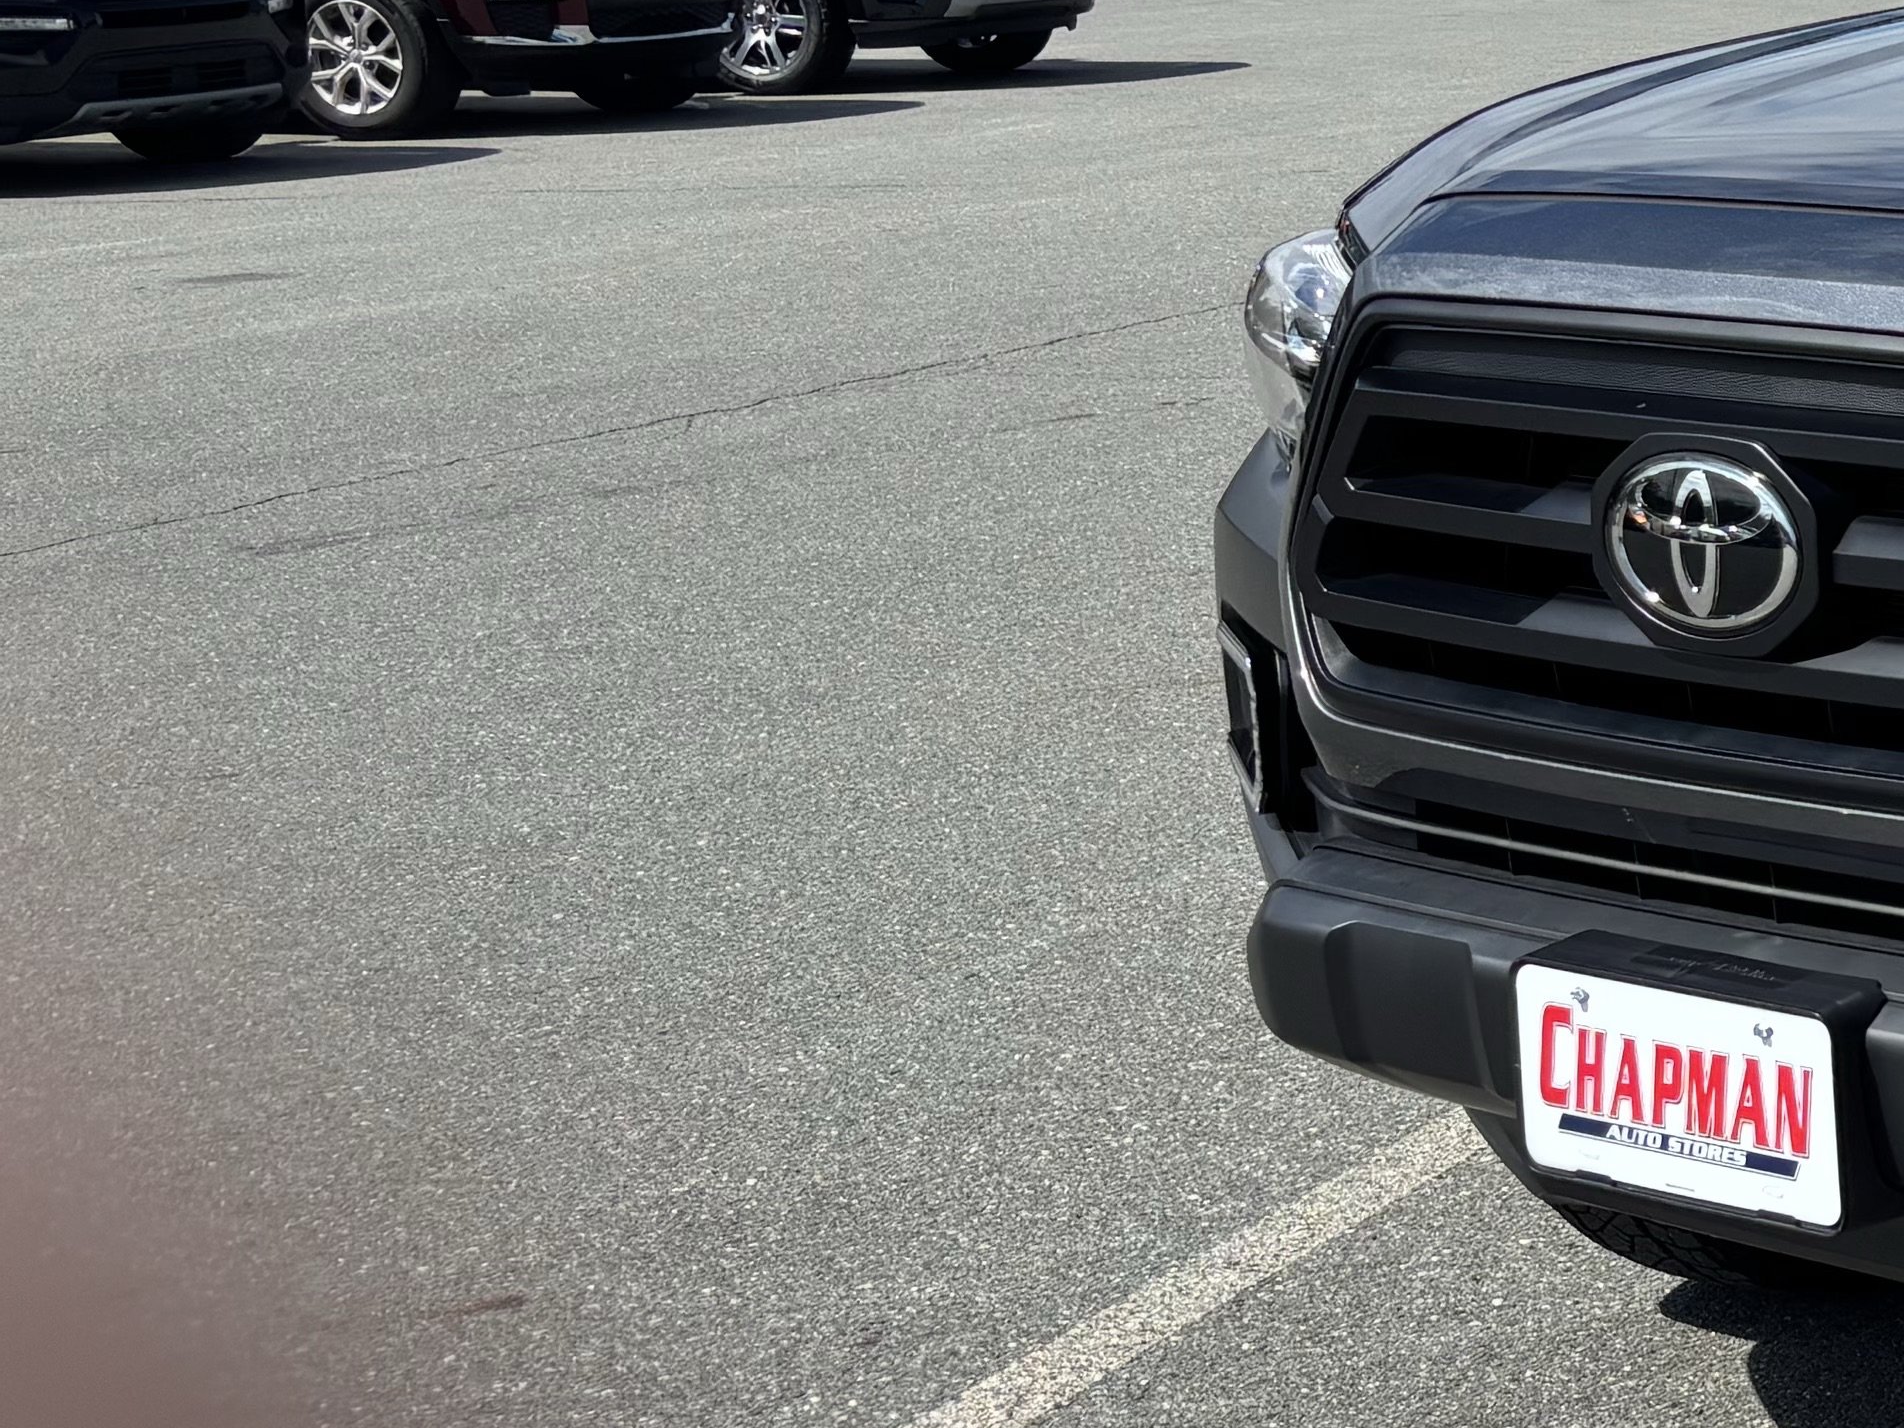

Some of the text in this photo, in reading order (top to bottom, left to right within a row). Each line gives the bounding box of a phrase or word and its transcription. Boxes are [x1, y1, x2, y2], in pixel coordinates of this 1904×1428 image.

[1538, 1000, 1814, 1159] CHAPMAN
[1605, 1124, 1749, 1167] AUTO STORES
